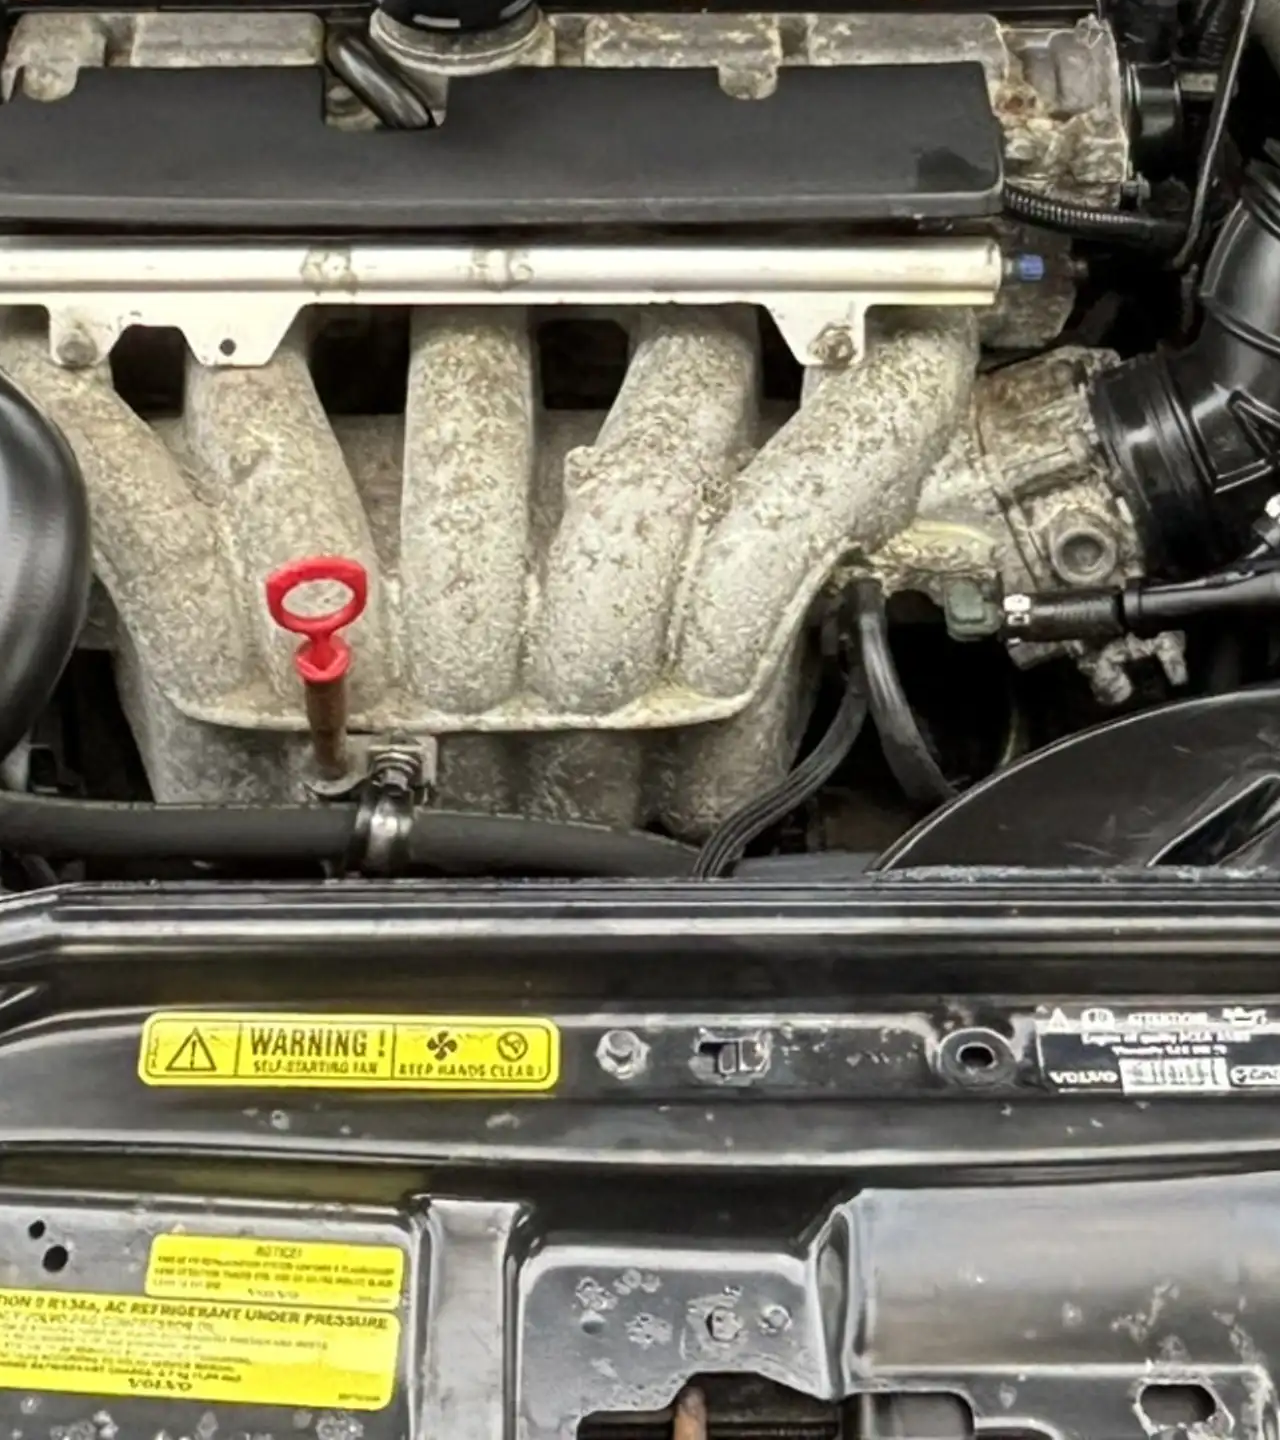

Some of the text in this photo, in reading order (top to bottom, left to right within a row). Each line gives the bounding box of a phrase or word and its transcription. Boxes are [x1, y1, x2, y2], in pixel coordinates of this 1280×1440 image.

[250, 1027, 386, 1058] WARNING !
[253, 1059, 378, 1075] SELF-STARTING FAN
[398, 1062, 434, 1076] KEEP
[437, 1063, 486, 1078] HANDS
[1049, 1070, 1119, 1085] VOLVO
[104, 1300, 128, 1314] AC
[130, 1302, 242, 1321] REFRIGERANT
[244, 1310, 301, 1325] UNDER
[304, 1313, 390, 1330] PRESSURE
